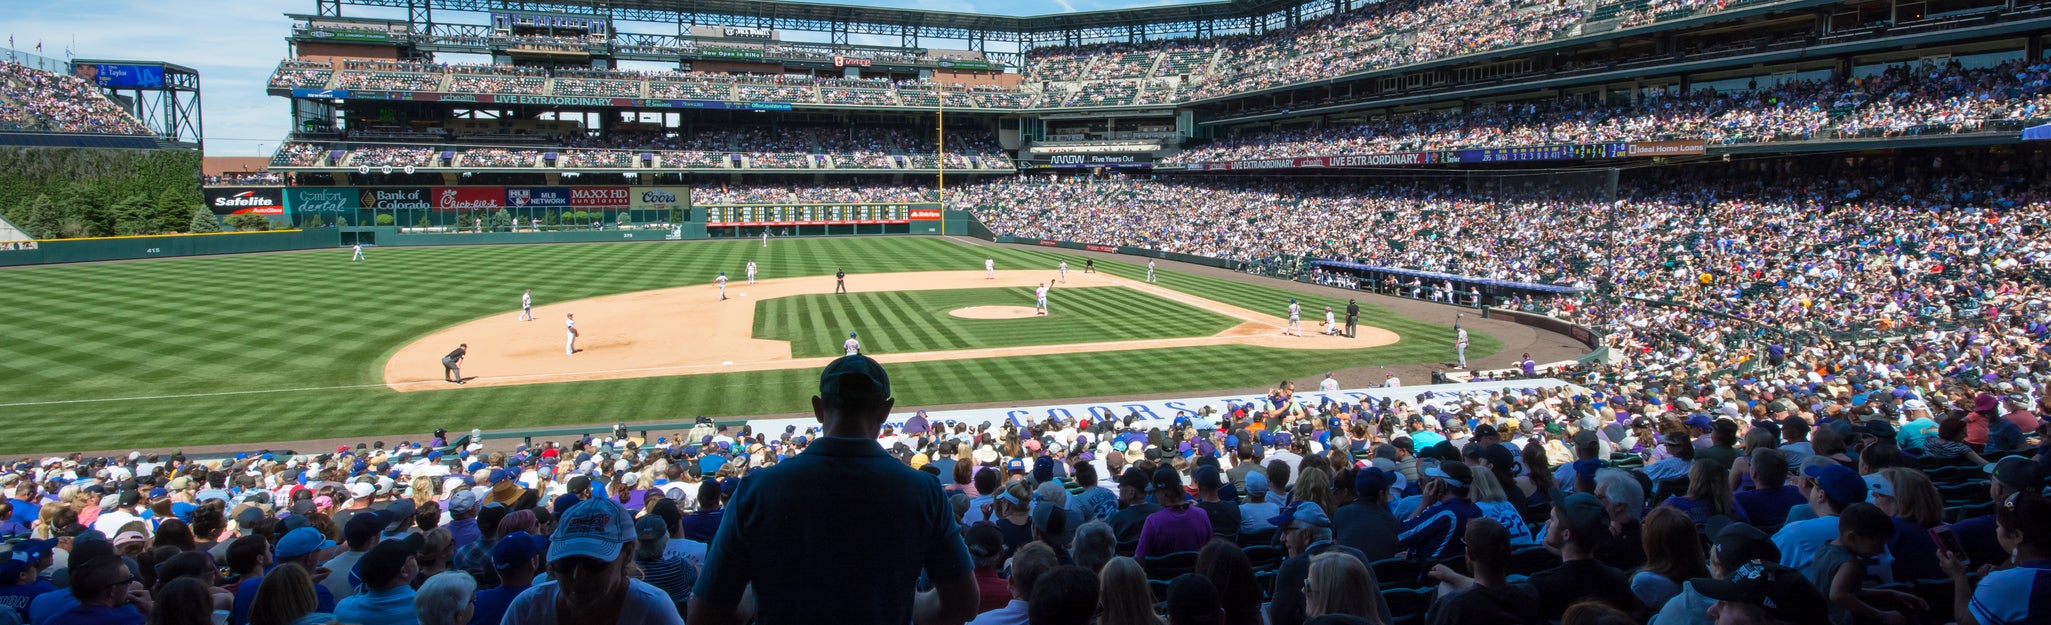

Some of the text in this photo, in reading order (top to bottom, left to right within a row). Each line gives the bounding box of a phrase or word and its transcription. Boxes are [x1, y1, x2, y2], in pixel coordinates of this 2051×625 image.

[492, 12, 605, 29] THE ROOFTOP
[109, 69, 127, 78] Taylor
[493, 95, 517, 104] LIVE
[519, 96, 615, 107] EXTRAORDINARY.
[1656, 145, 1679, 153] Home
[1680, 144, 1704, 152] Loans
[1091, 154, 1135, 163] Five Years Out
[1231, 161, 1243, 169] LIVE
[1243, 158, 1296, 169] EXTRAORDINARY.
[1329, 156, 1346, 167] LIVE
[1346, 153, 1421, 166] EXTRAORDINARY.
[300, 189, 343, 201] Comfort
[376, 189, 420, 200] Bank of
[571, 189, 628, 199] MAXX HD
[642, 190, 676, 203] Coors
[215, 197, 274, 206] Safelite
[298, 198, 348, 212] dental
[377, 200, 430, 209] Colorado
[571, 198, 628, 206] sunglasses
